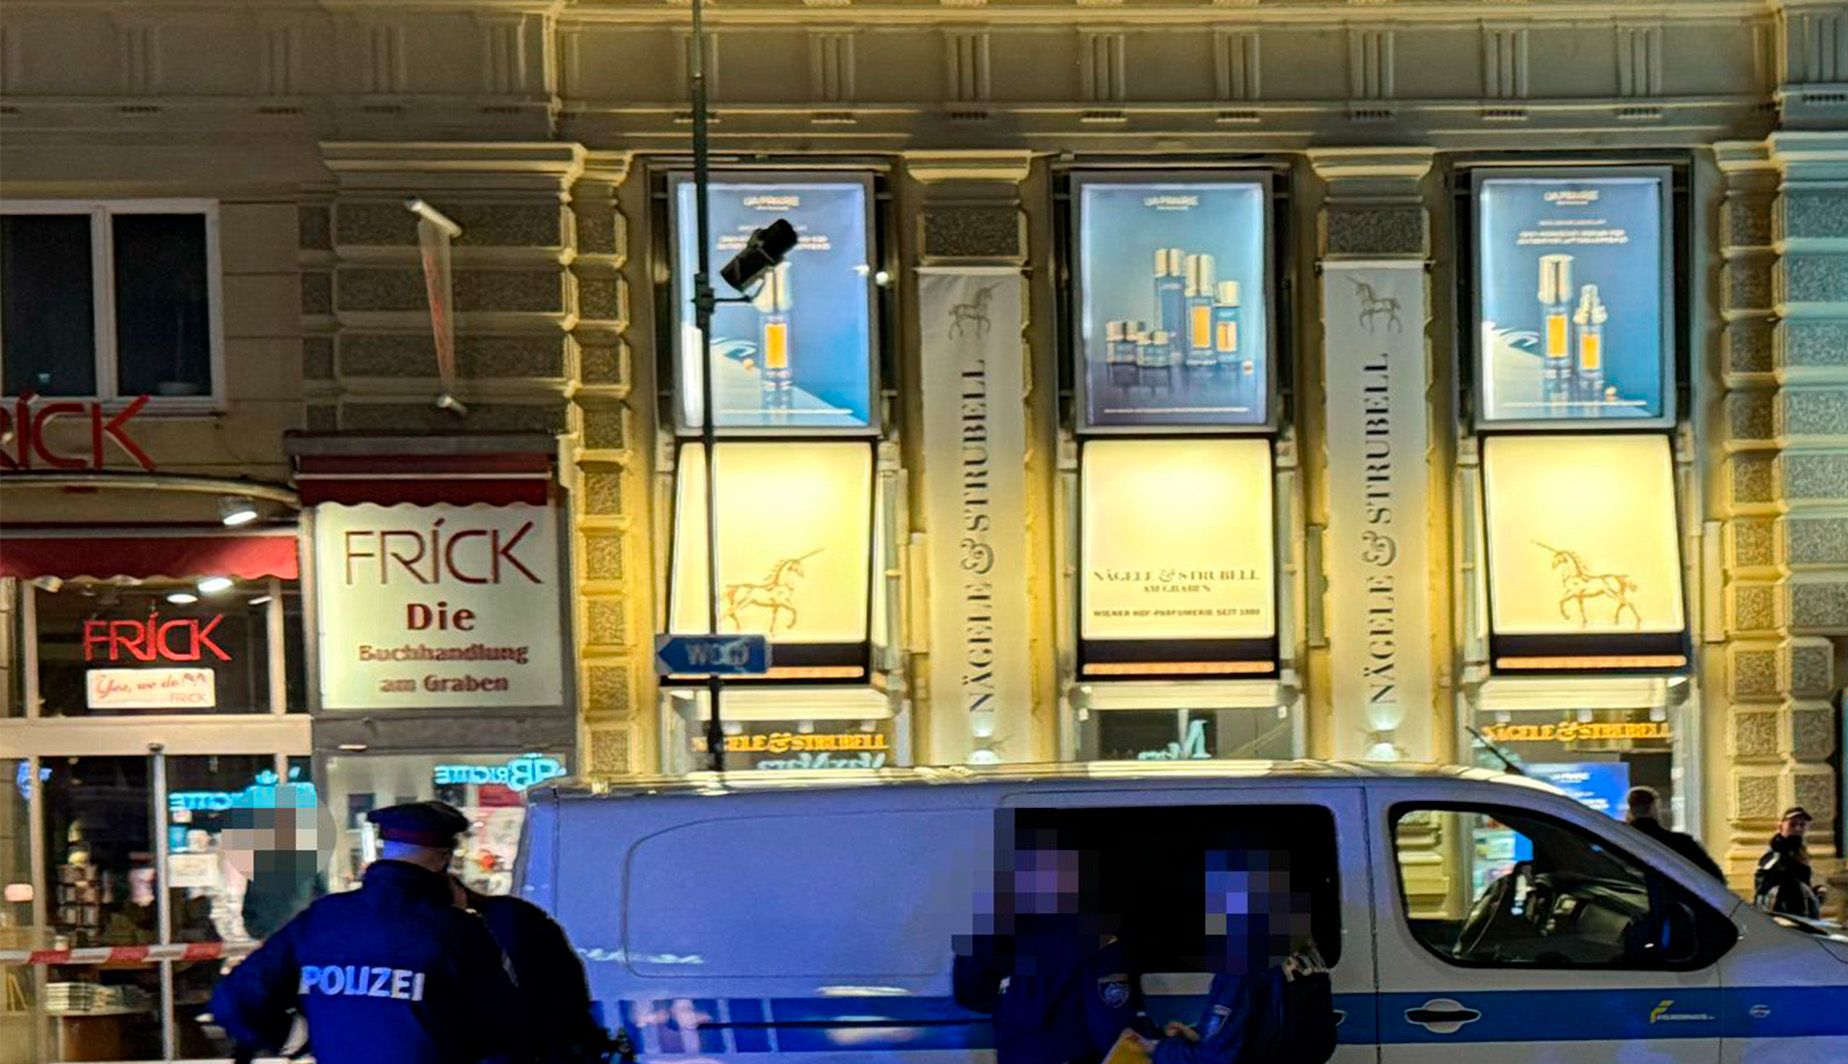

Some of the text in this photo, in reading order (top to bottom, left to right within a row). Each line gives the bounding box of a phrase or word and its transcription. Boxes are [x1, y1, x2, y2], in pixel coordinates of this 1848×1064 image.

[0, 389, 156, 474] ÍCK
[960, 359, 995, 713] NÄGELE & STRUBELL
[1362, 353, 1397, 705] NÄGELE & STRUBELL
[345, 518, 544, 584] FRÍCK
[1178, 569, 1260, 581] STRUBELL
[406, 601, 476, 631] Die
[359, 643, 529, 665] Buchhandlung
[380, 675, 509, 692] am Graben
[691, 735, 768, 752] NELE
[791, 734, 890, 751] STRUBELL
[300, 965, 426, 1001] POLIZEI
